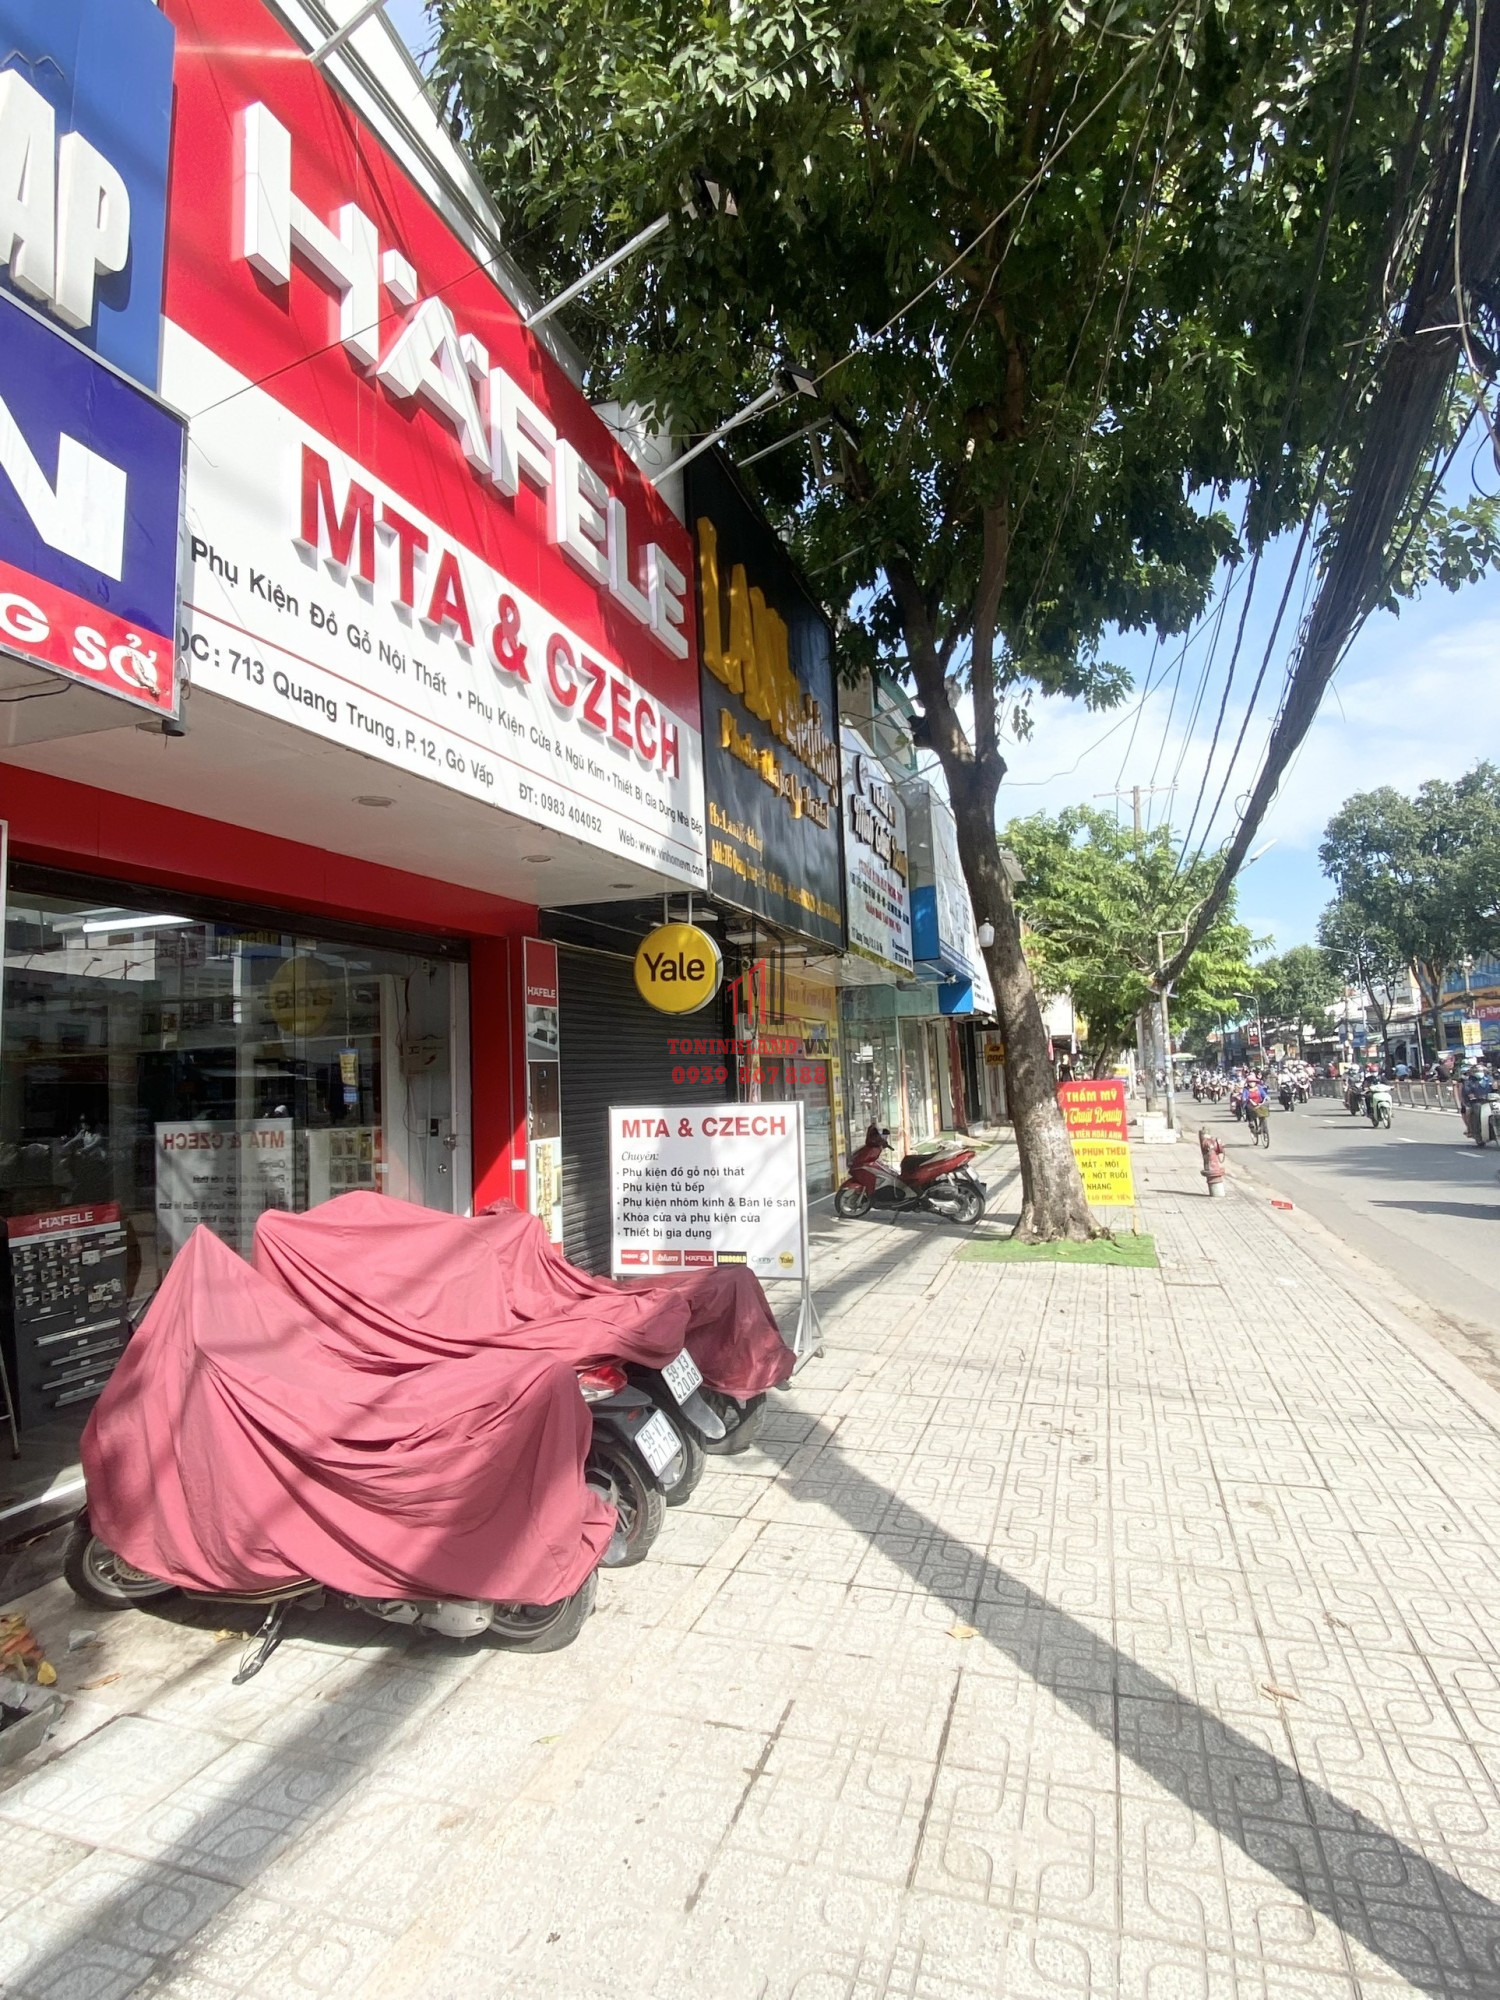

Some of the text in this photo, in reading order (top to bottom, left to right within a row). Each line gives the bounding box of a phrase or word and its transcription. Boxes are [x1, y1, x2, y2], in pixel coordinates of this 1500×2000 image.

[244, 101, 690, 660] HÄFELE
[301, 441, 680, 780] MTA & CZECH
[191, 535, 239, 587] Phụ
[249, 568, 299, 616] Kiện
[310, 602, 338, 636] Đồ
[347, 623, 372, 654] Gỗ
[379, 640, 406, 674] Nội
[412, 659, 447, 696] Thất
[468, 690, 493, 723] Phụ
[498, 707, 525, 737] Kiện
[530, 726, 551, 751] Cửa
[556, 740, 562, 757] &
[587, 761, 605, 781] Kim
[612, 772, 633, 797] Thiết
[645, 791, 656, 810] Gia
[659, 799, 676, 826] Dụng
[229, 648, 265, 685] 713
[273, 671, 338, 722] Quang
[346, 702, 401, 748] Trung,
[446, 748, 465, 774] Gò
[471, 759, 494, 788] Vấp
[540, 795, 566, 817] 0983
[568, 807, 602, 832] 404052
[642, 952, 705, 982] Yale
[527, 985, 556, 999] HÄFELE
[622, 1116, 786, 1138] MTA & CZECH
[1095, 1106, 1123, 1127] Beauty
[622, 1168, 642, 1178] Phụ
[645, 1167, 667, 1178] kiện
[703, 1167, 719, 1178] nội
[622, 1183, 642, 1194] Phụ
[645, 1182, 667, 1194] kiện
[685, 1182, 705, 1194] bếp
[622, 1198, 642, 1209] Phụ
[645, 1198, 667, 1209] kiện
[670, 1198, 699, 1207] nhôm
[702, 1197, 724, 1207] kính
[728, 1198, 736, 1207] &
[39, 1211, 94, 1230] HÄFELE
[623, 1212, 649, 1222] Khóa
[653, 1212, 672, 1222] cửa
[674, 1213, 687, 1222] và
[690, 1212, 711, 1224] phụ
[713, 1213, 737, 1223] kiện
[623, 1227, 650, 1237] Thiết
[666, 1228, 682, 1240] gia
[685, 1228, 712, 1240] dụng
[657, 1254, 679, 1262] blum
[666, 1354, 689, 1383] 59-X3
[640, 1416, 666, 1449] 59-V1
[648, 1432, 678, 1470] 771.79
